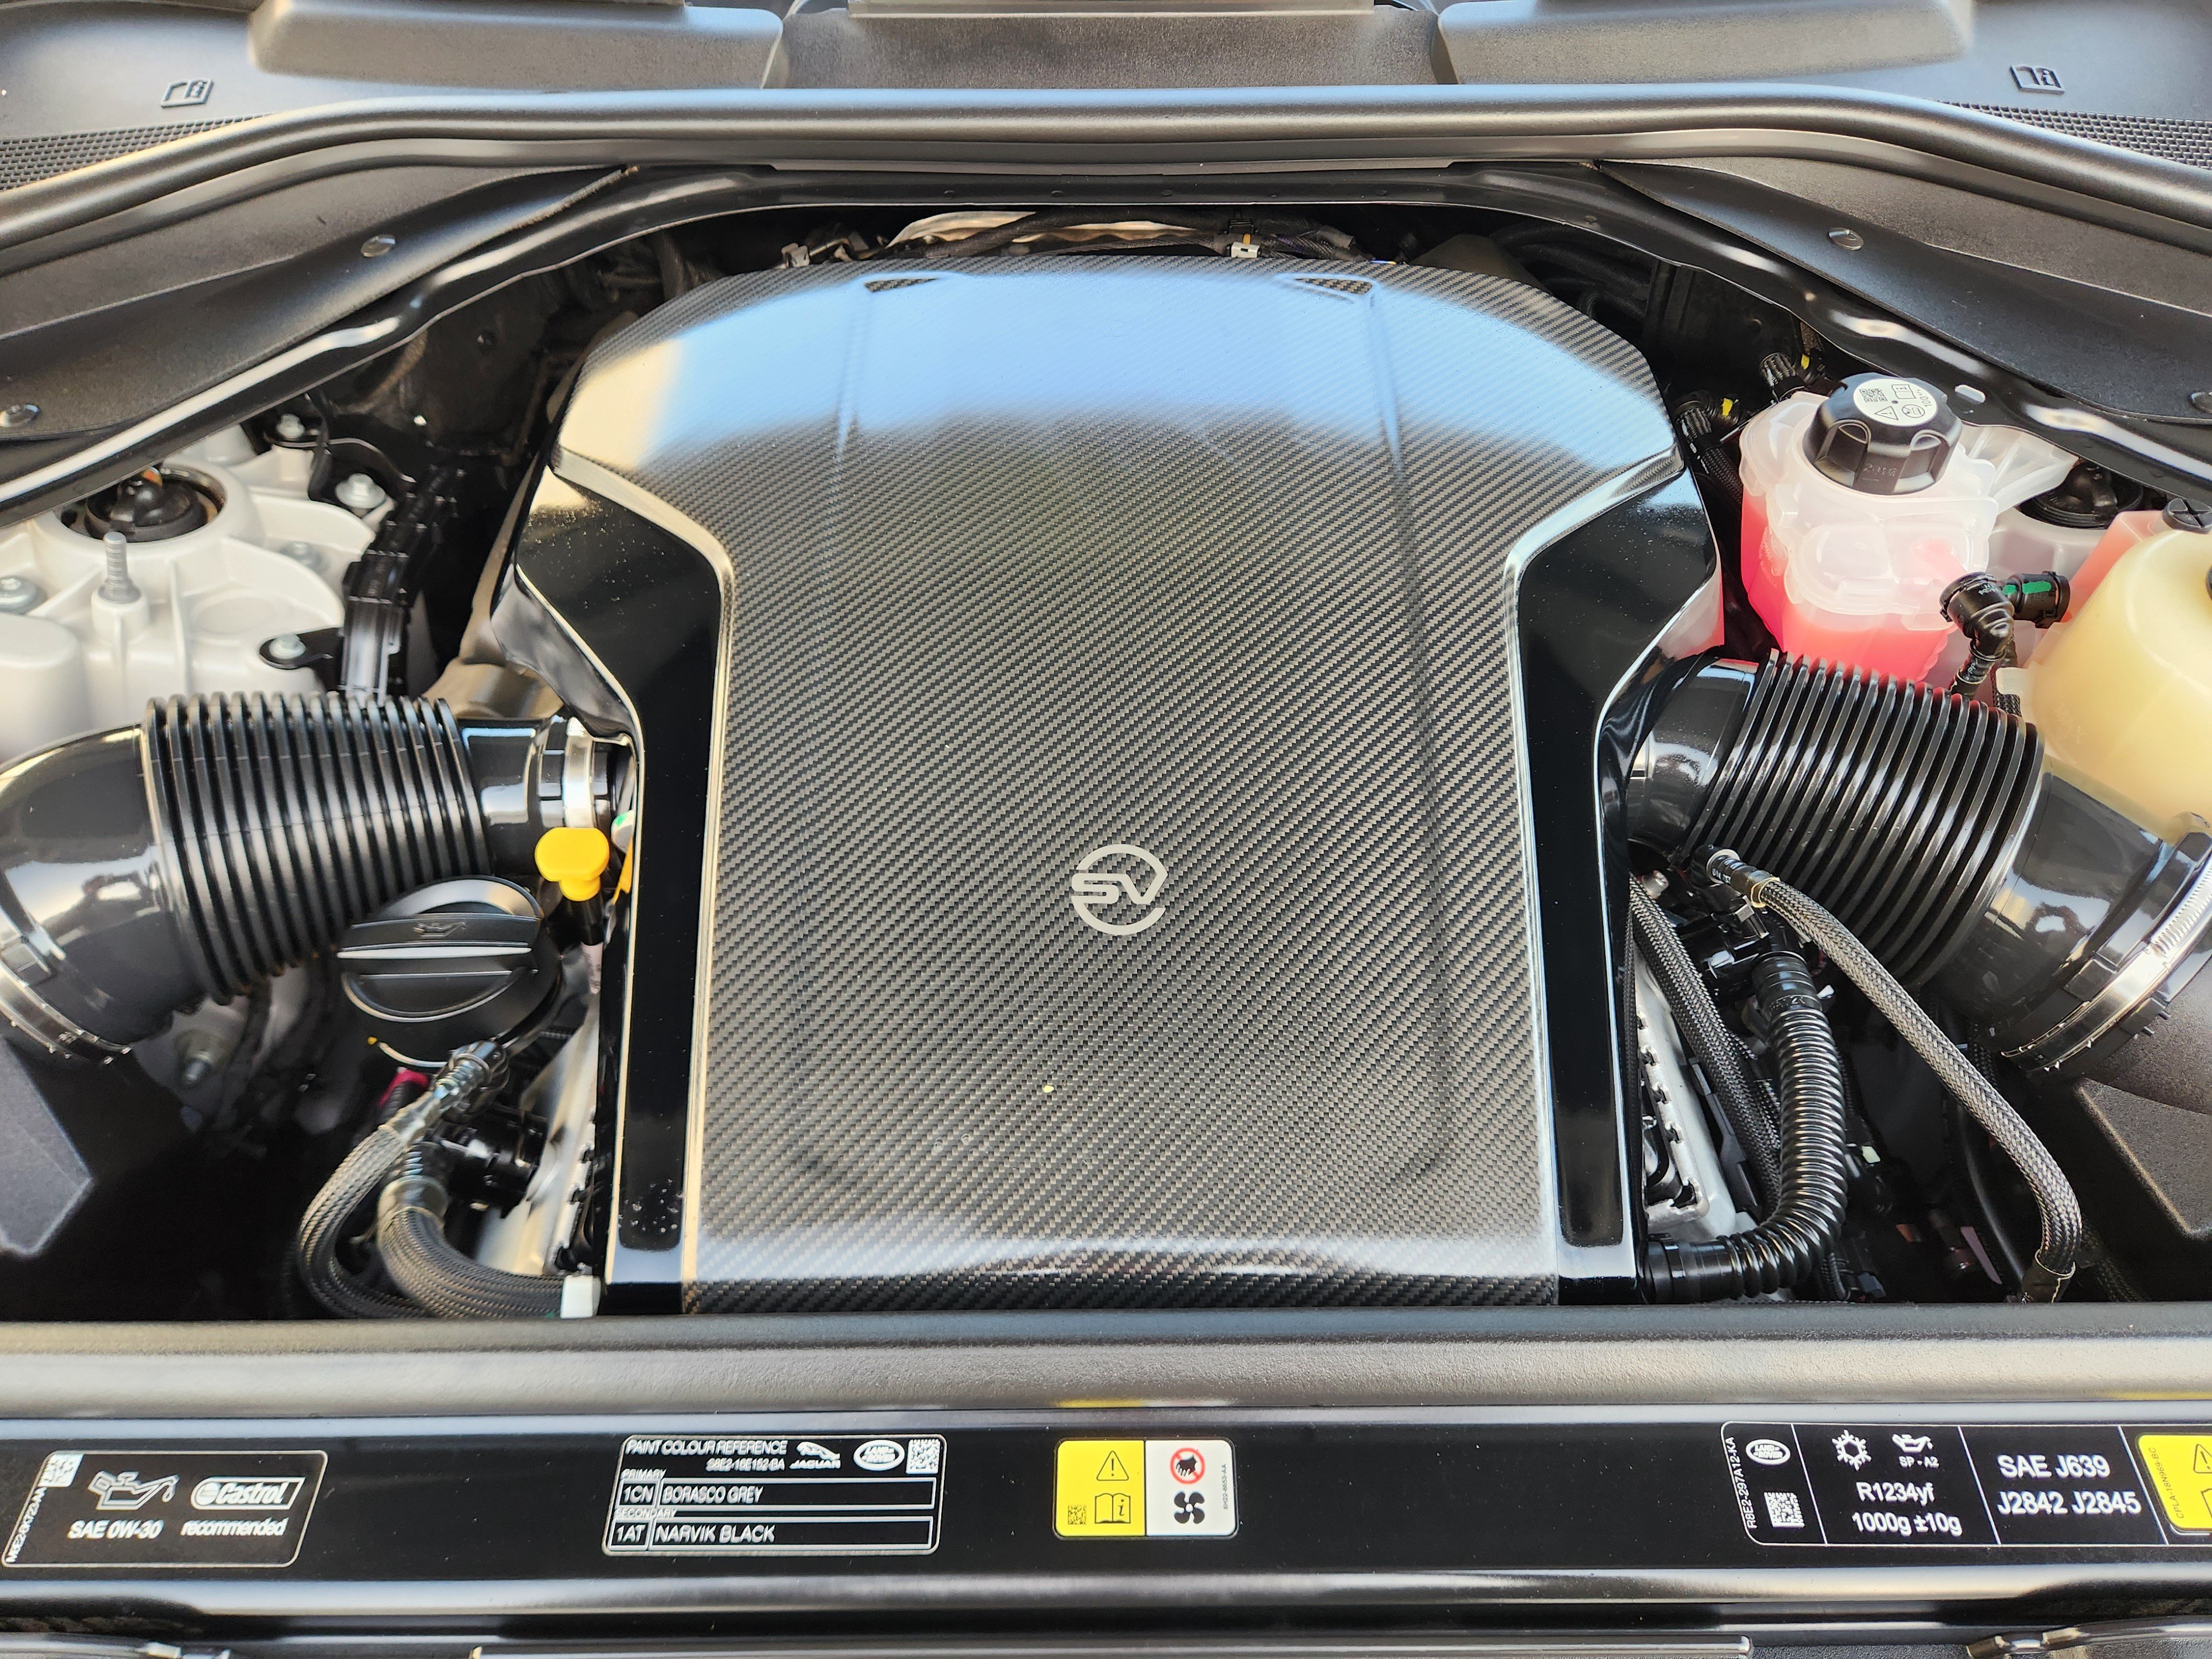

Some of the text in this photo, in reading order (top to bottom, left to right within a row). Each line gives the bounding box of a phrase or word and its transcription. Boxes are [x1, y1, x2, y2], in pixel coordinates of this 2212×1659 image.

[625, 1439, 789, 1455] PAINT COLOUR REFERENCE
[1754, 1444, 1775, 1452] LAND
[1758, 1450, 1784, 1459] ROVER
[789, 1459, 841, 1469] JAGUAR
[1997, 1454, 2111, 1479] SAE J639
[620, 1468, 667, 1480] PRIMARY
[1726, 1436, 1758, 1529] R8E2-297A12-KA
[216, 1481, 286, 1505] Castrol
[623, 1485, 764, 1504] 1CN BORASCO GREY
[1856, 1481, 1936, 1506] R1234yf
[1996, 1490, 2141, 1515] J2842 J2845
[613, 1507, 678, 1519] SECONDARY
[67, 1520, 164, 1539] SAE 0W-30
[180, 1517, 289, 1536] recommended
[616, 1525, 775, 1543] 1AT NARVIK BLACK
[1851, 1512, 1963, 1537] 1000g ±10g
